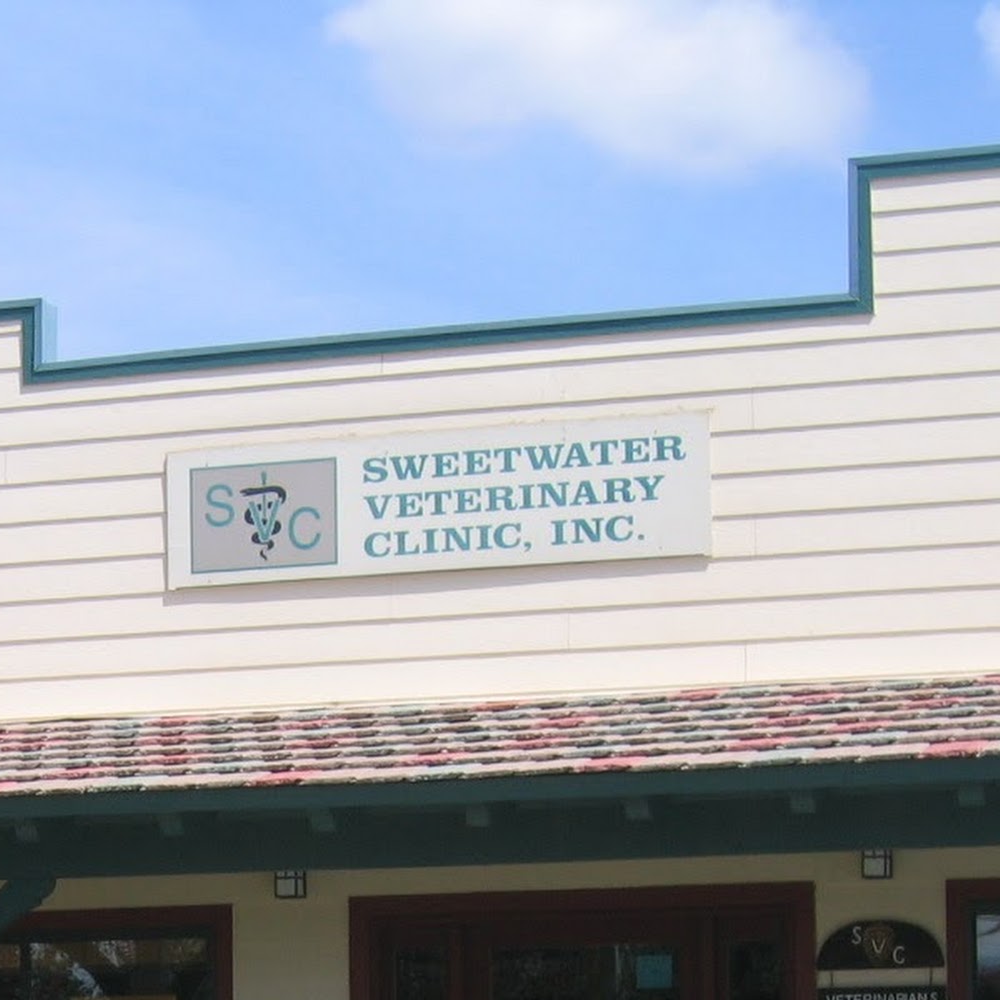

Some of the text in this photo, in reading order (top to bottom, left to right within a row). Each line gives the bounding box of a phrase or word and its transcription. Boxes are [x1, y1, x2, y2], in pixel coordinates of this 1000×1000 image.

[363, 435, 686, 484] SWEETWATER
[364, 475, 664, 519] VETERINARY
[363, 515, 646, 558] CLINIC, INC.
